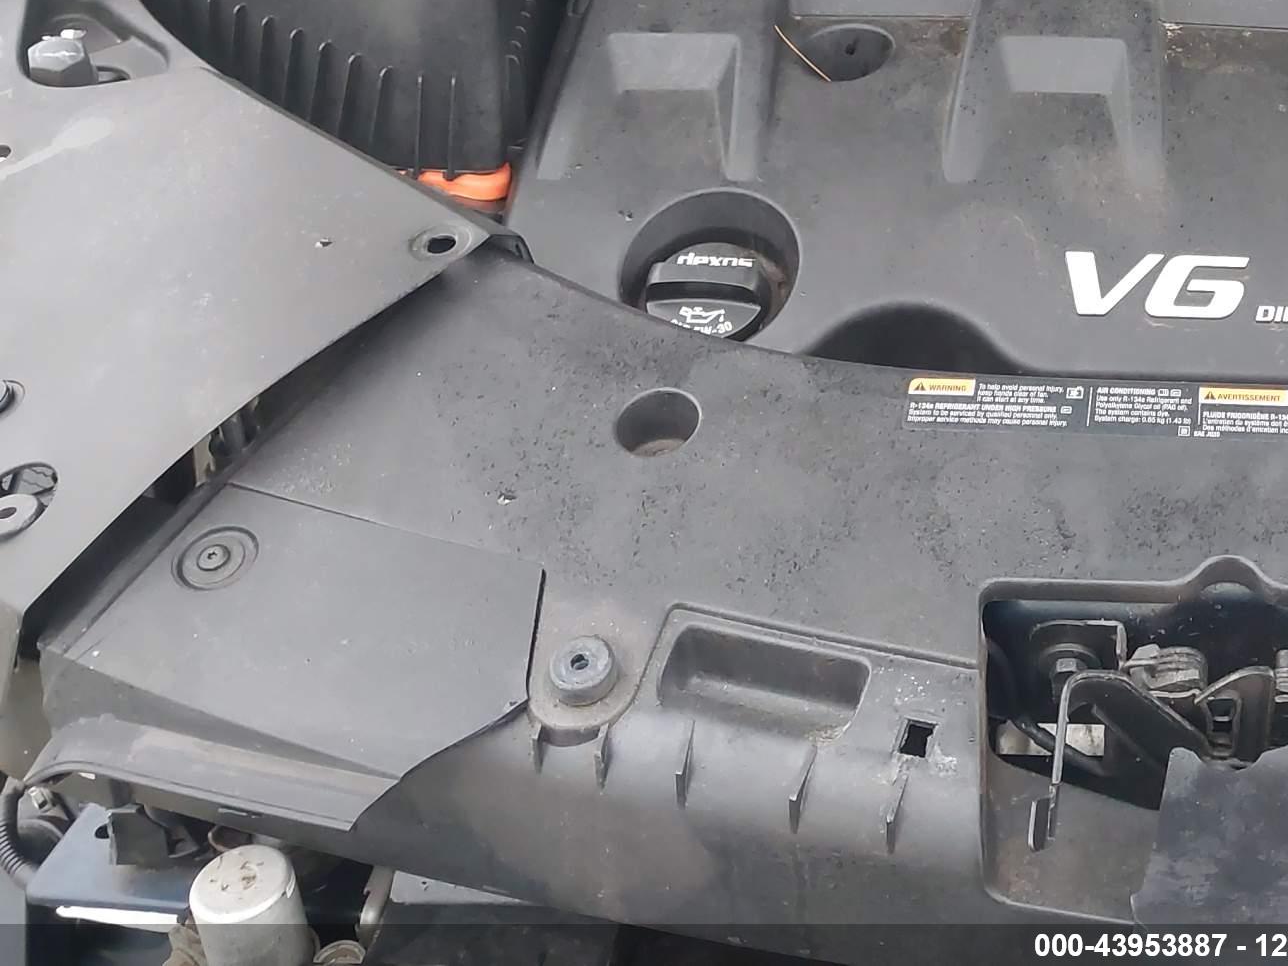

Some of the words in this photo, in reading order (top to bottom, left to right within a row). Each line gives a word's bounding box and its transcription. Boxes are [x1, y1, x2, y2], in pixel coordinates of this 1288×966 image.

[1066, 251, 1249, 317] V6
[928, 384, 967, 393] WARNING
[1109, 387, 1156, 396] CONDITIONING
[1217, 392, 1281, 402] AVERTISSEMENT
[935, 402, 981, 411] REFRIGERANT
